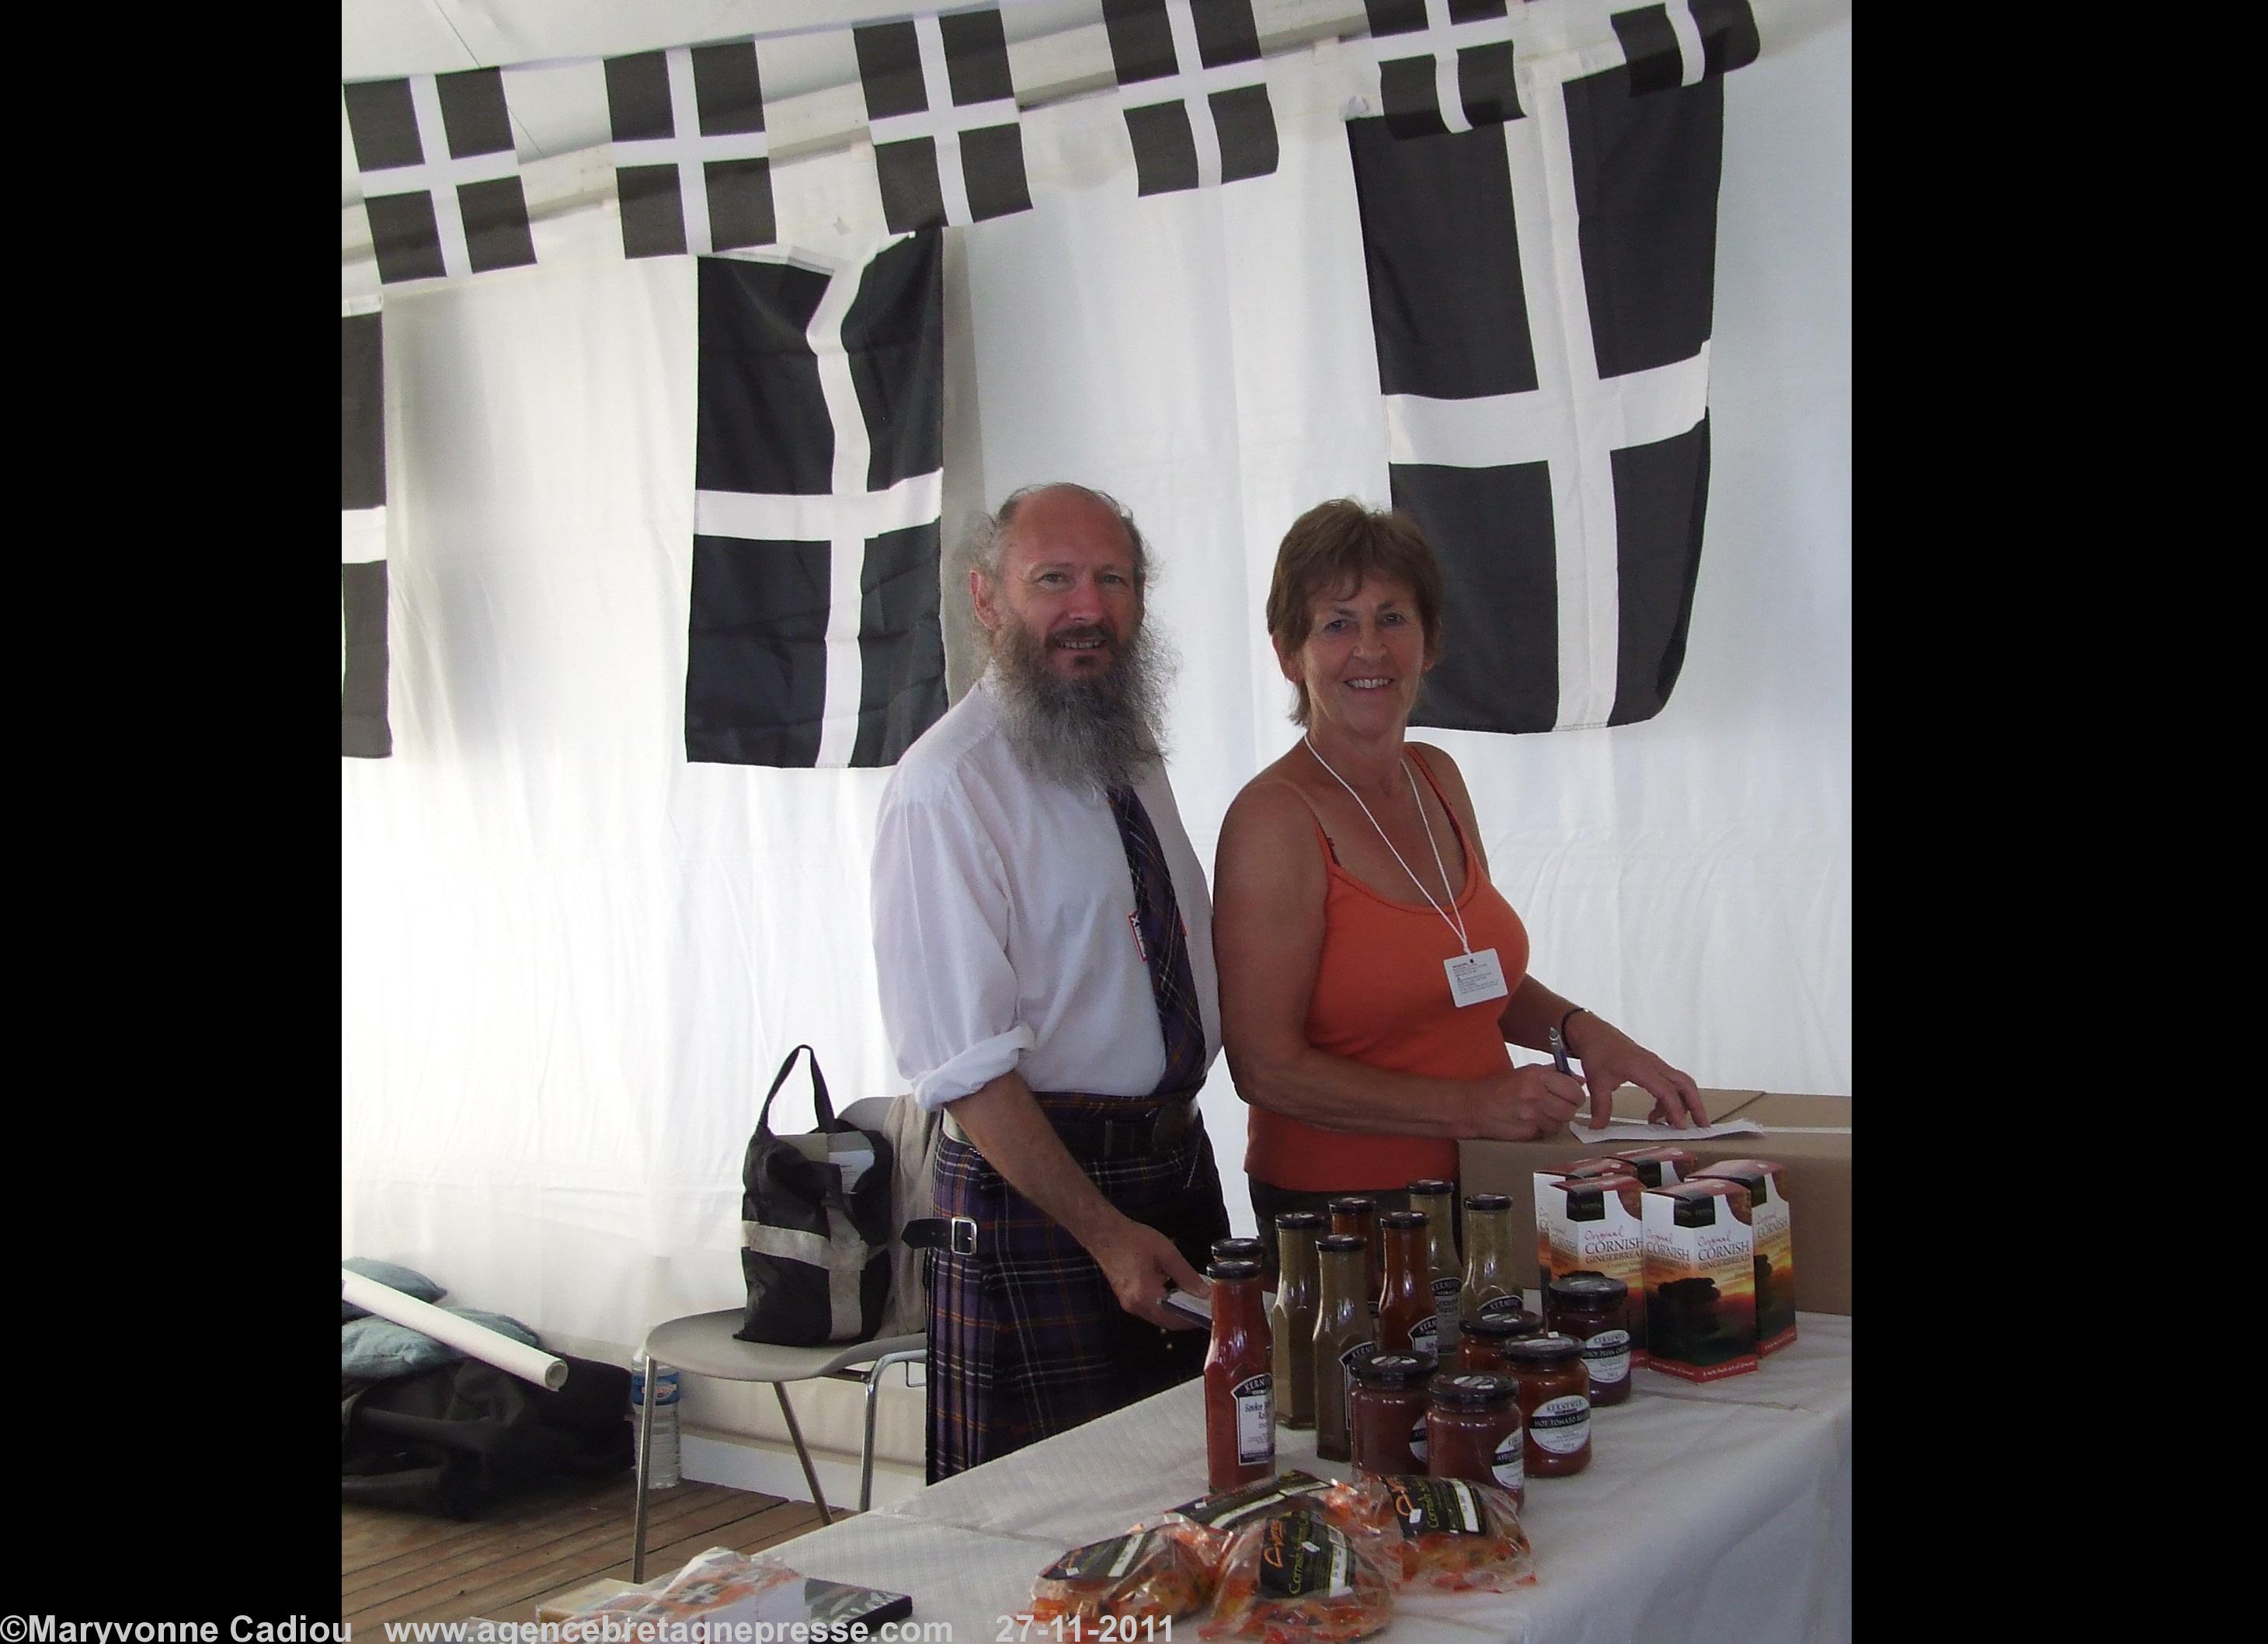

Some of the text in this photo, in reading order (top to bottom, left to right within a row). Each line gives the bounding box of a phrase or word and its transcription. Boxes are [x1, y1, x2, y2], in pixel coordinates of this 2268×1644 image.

[1646, 1242, 1690, 1262] CORNISH
[1698, 1241, 1750, 1262] CORNISH
[1698, 1253, 1751, 1271] GINGERBREAD
